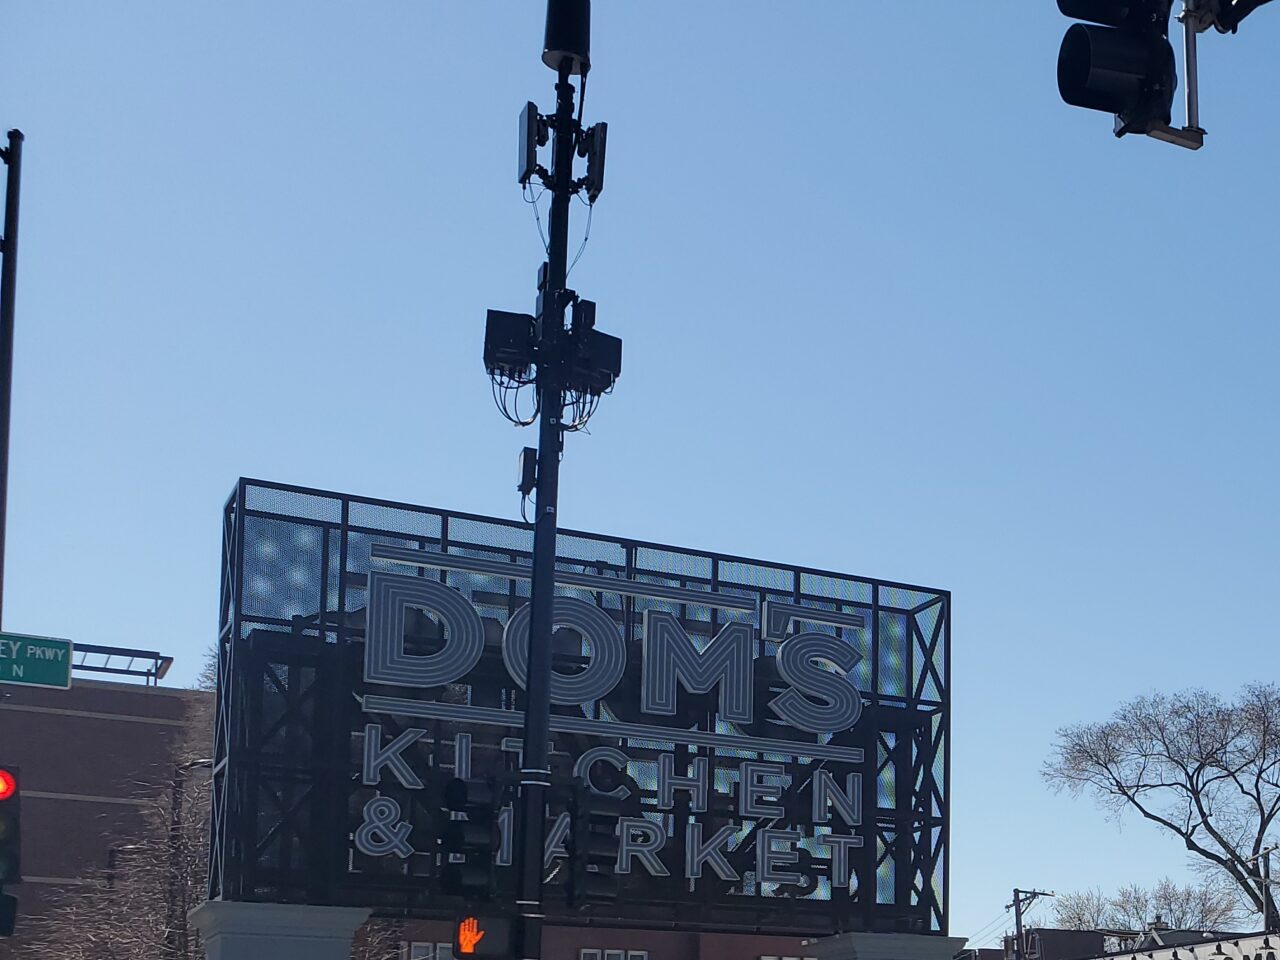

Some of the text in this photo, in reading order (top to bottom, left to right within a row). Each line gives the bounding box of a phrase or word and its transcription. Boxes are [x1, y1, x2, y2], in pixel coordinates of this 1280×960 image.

[26, 645, 65, 661] PKWY
[12, 664, 24, 677] N
[354, 796, 415, 858] &
